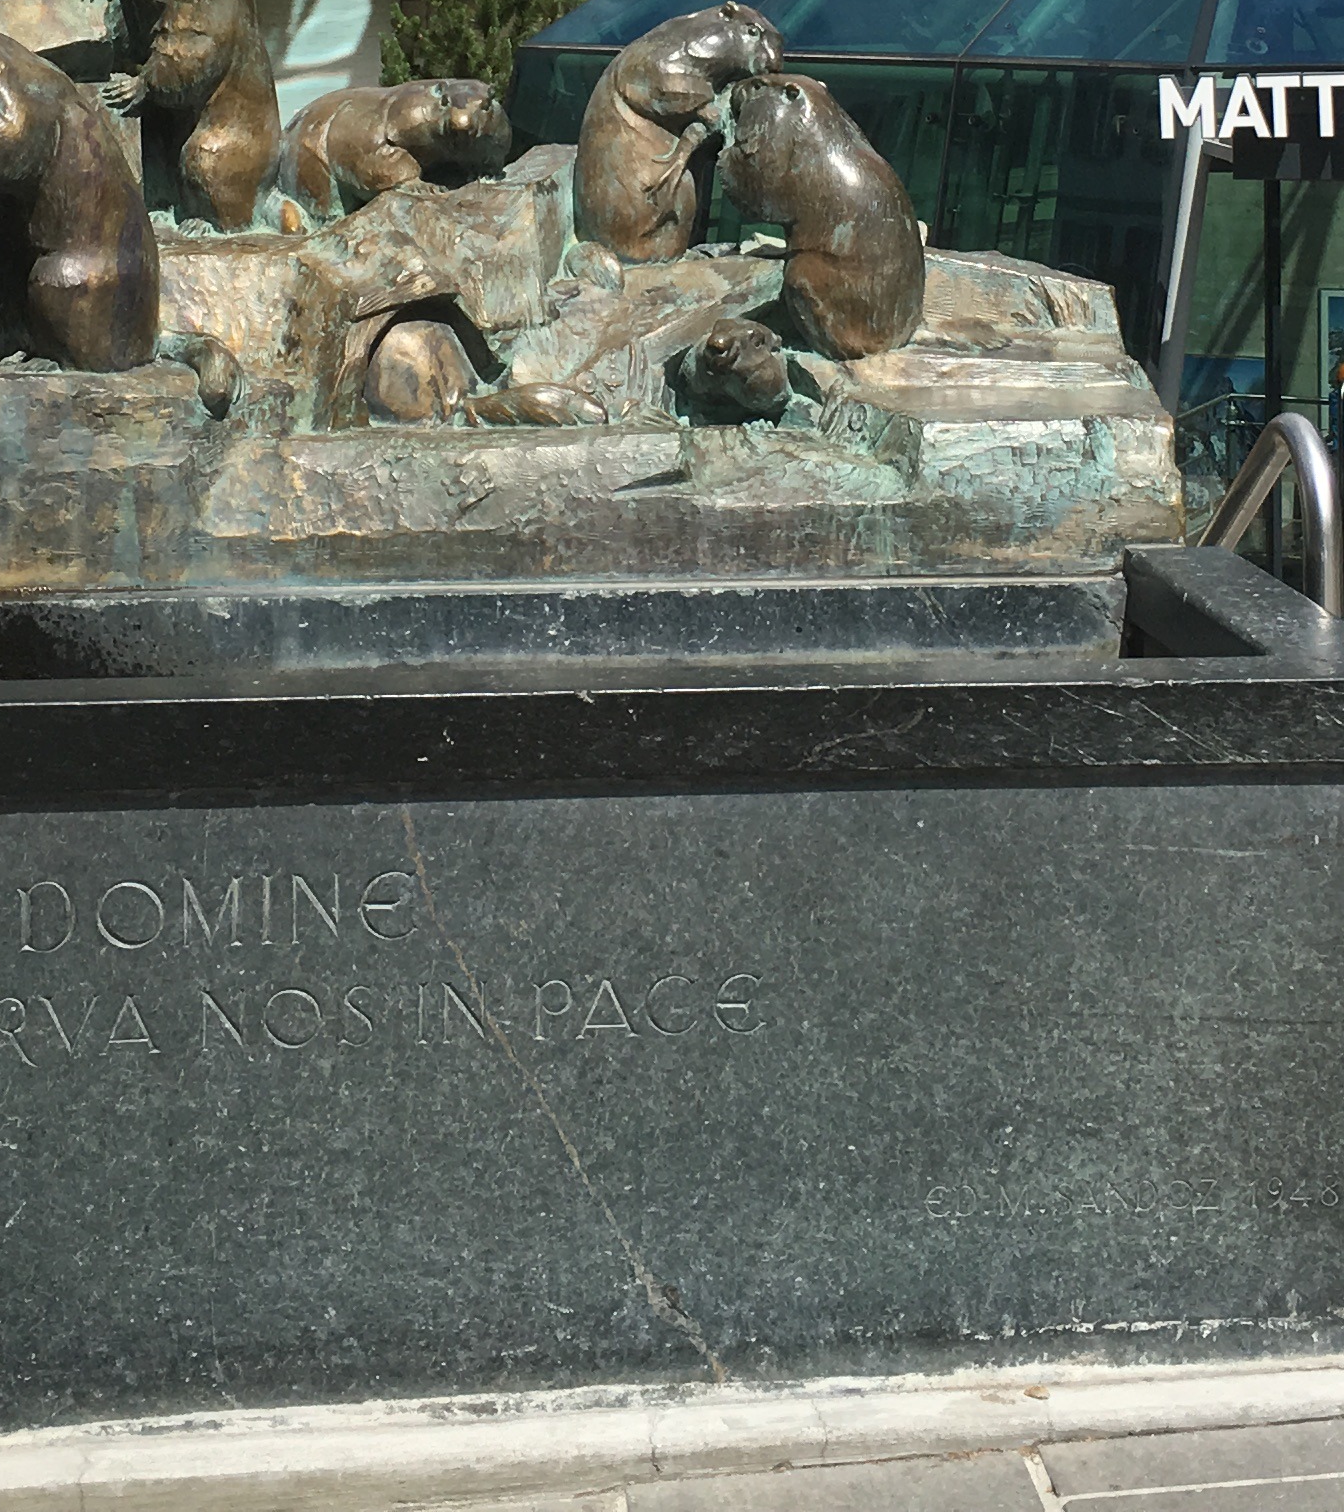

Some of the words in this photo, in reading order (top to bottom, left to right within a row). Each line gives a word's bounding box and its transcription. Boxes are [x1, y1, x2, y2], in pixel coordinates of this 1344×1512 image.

[16, 871, 419, 953] DOMINE
[199, 986, 374, 1050] NOS
[416, 981, 487, 1045] IN
[532, 973, 769, 1041] PACE
[1249, 1175, 1340, 1209] 1948
